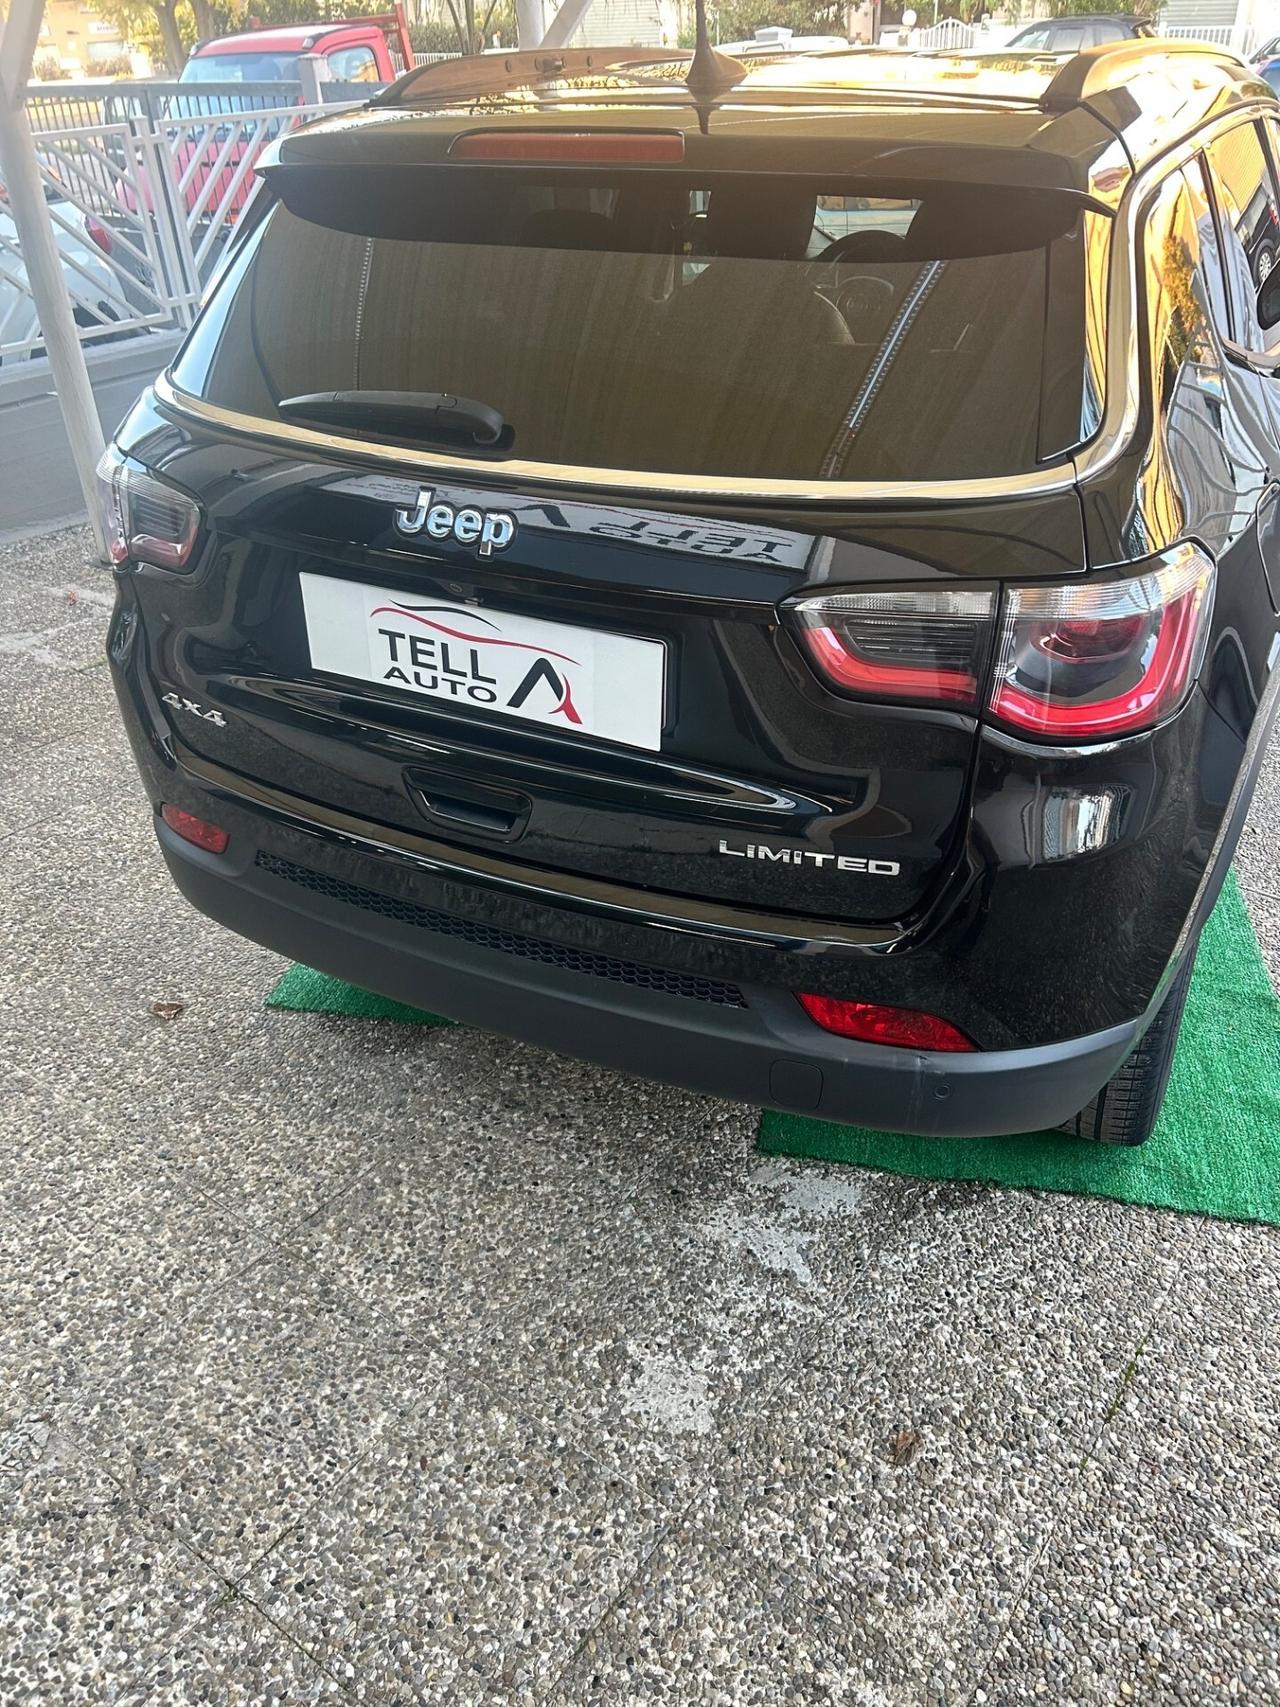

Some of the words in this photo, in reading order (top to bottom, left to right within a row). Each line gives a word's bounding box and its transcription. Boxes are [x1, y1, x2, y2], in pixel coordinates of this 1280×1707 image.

[394, 489, 516, 557] Jeep
[378, 627, 497, 685] TELL
[384, 665, 498, 704] AUTO
[719, 839, 900, 876] LIMITED
